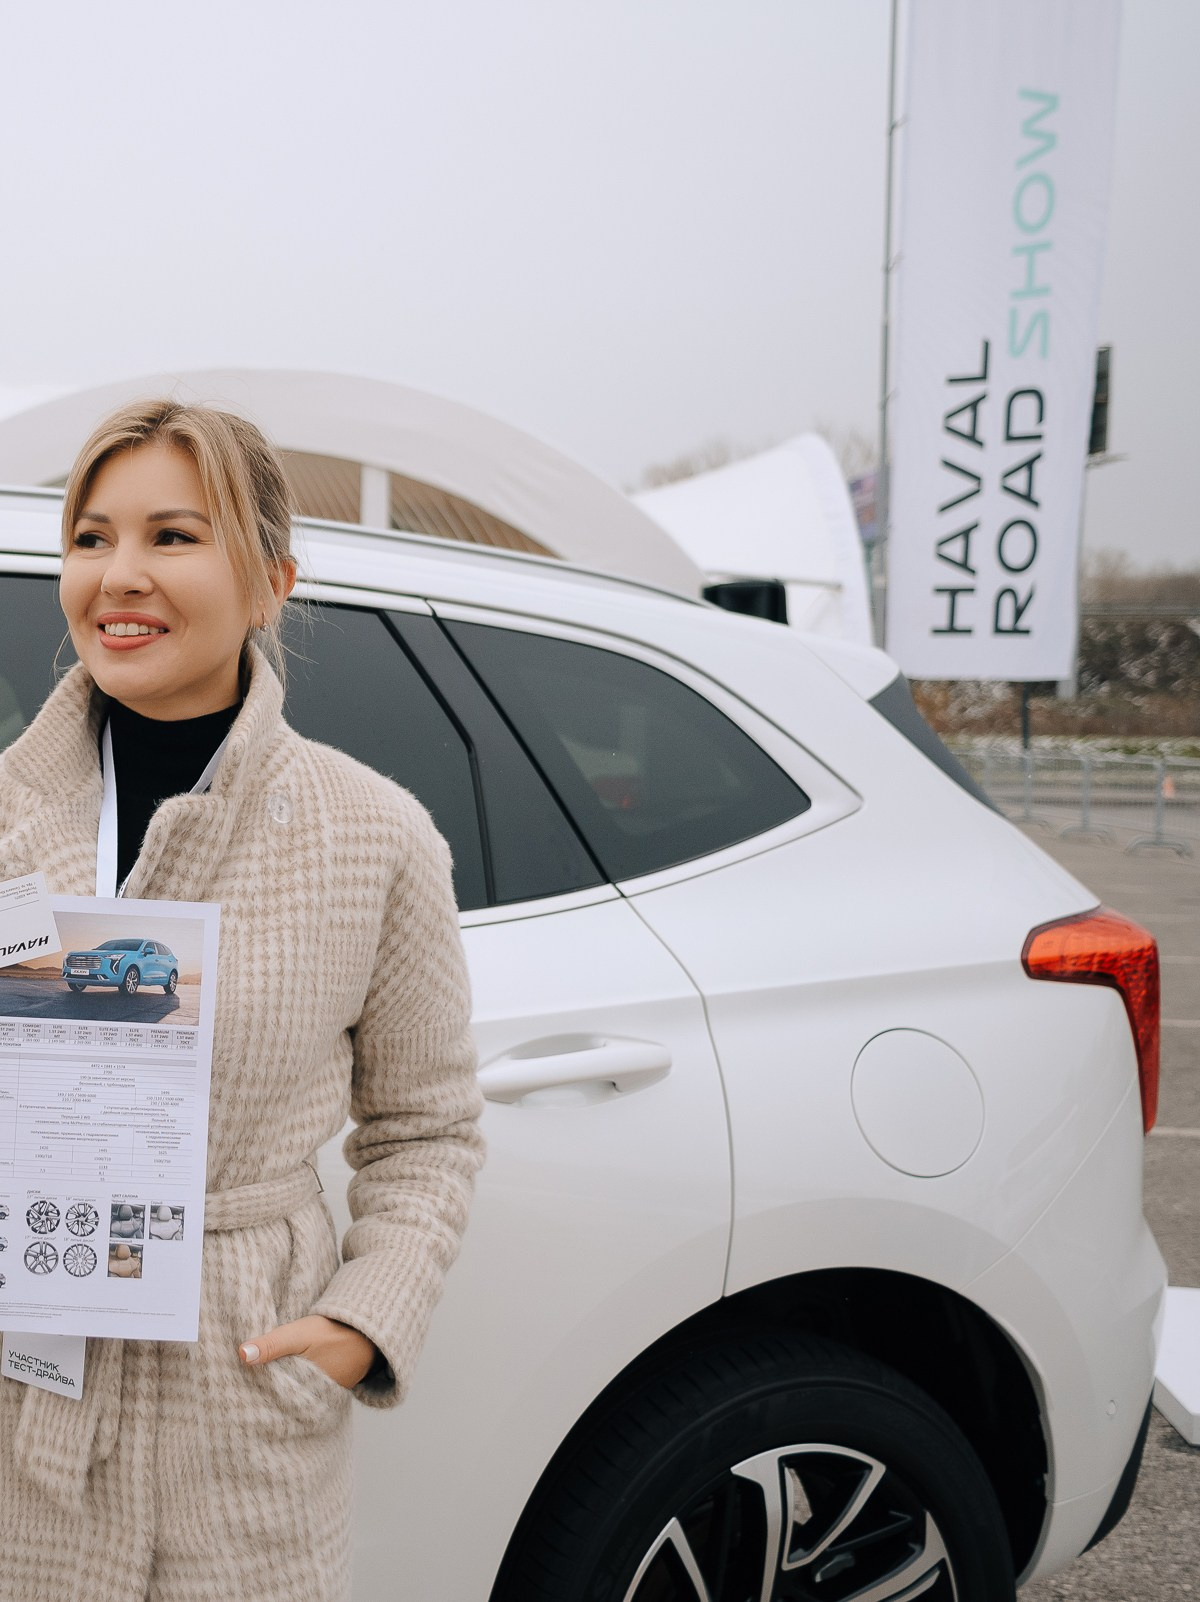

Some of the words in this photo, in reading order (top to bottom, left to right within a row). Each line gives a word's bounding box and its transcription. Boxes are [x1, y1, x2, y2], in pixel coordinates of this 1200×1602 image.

[1008, 87, 1060, 360] SHOW
[931, 339, 990, 638] HAVAL
[992, 387, 1045, 638] ROAD
[7, 1359, 76, 1387] ТЕСТ-ДРАЙВА
[8, 1349, 60, 1373] УЧАСТНИК
